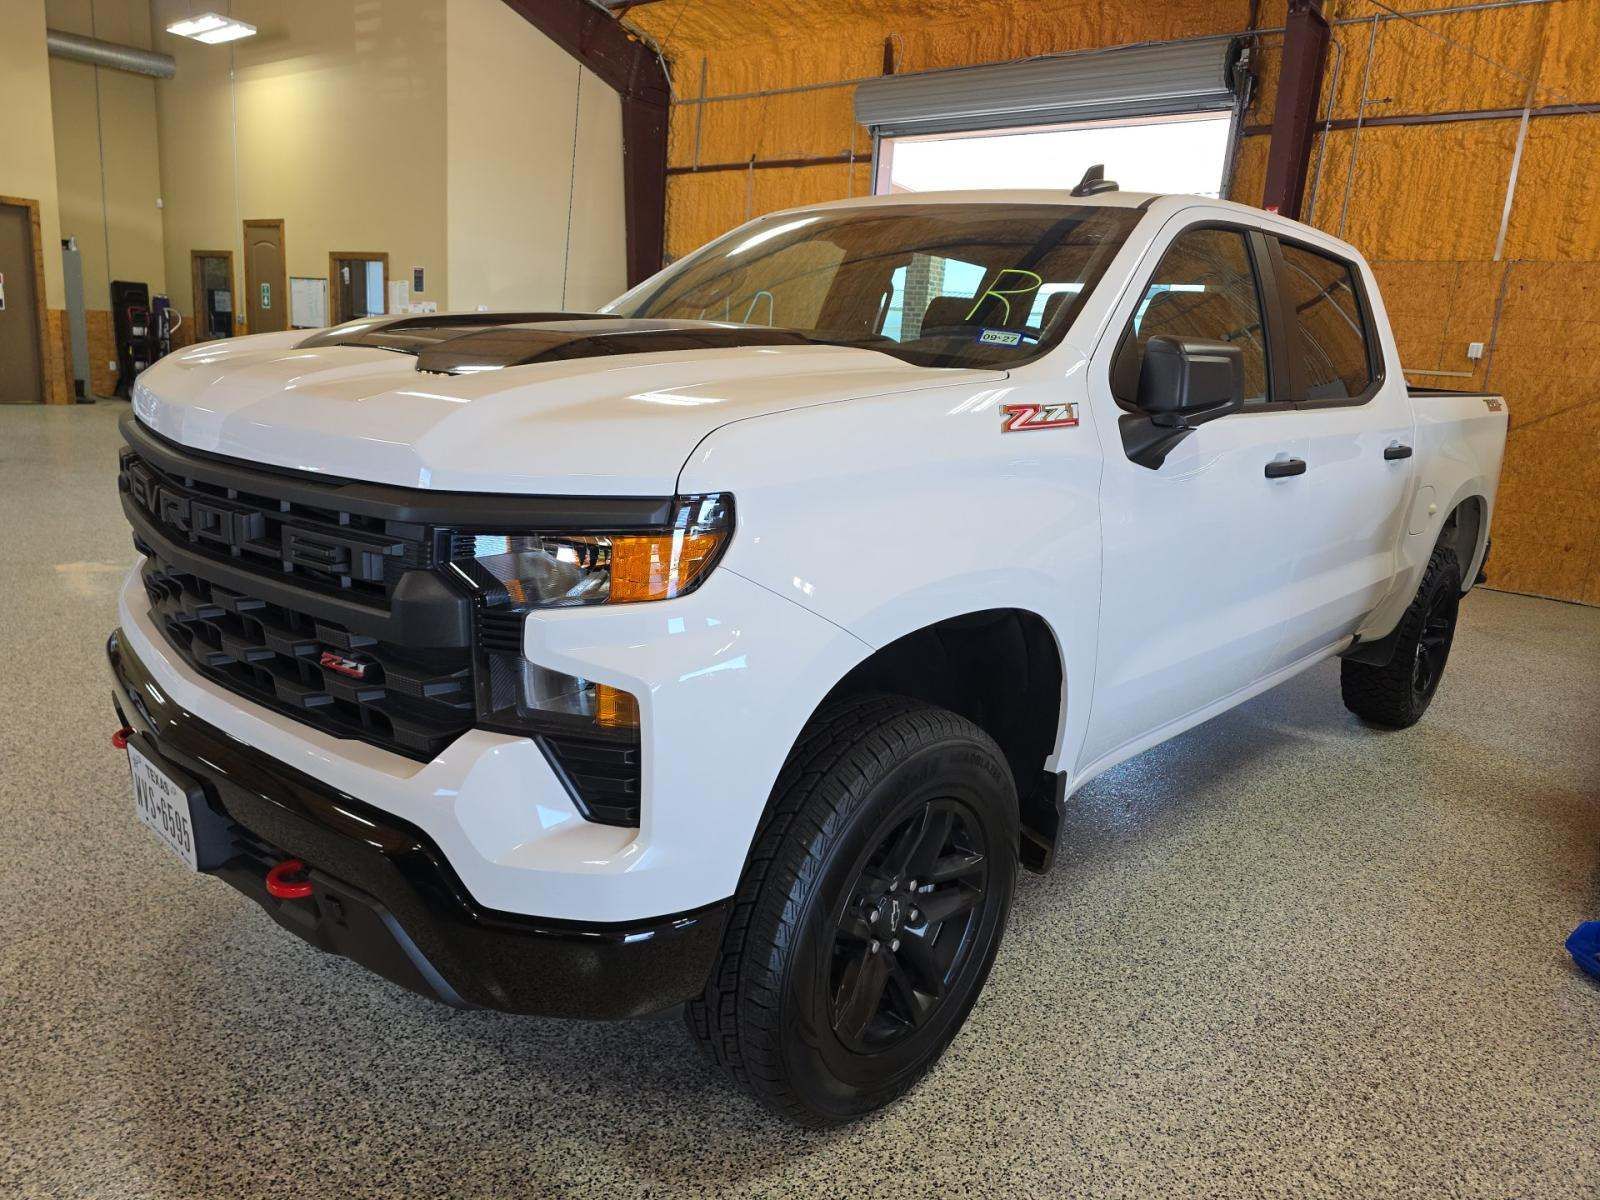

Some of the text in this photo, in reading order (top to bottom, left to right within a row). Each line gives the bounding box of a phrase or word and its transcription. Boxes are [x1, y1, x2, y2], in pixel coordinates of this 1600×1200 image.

[965, 268, 1043, 326] R
[1000, 402, 1079, 433] Z71
[145, 763, 170, 796] TEXAS
